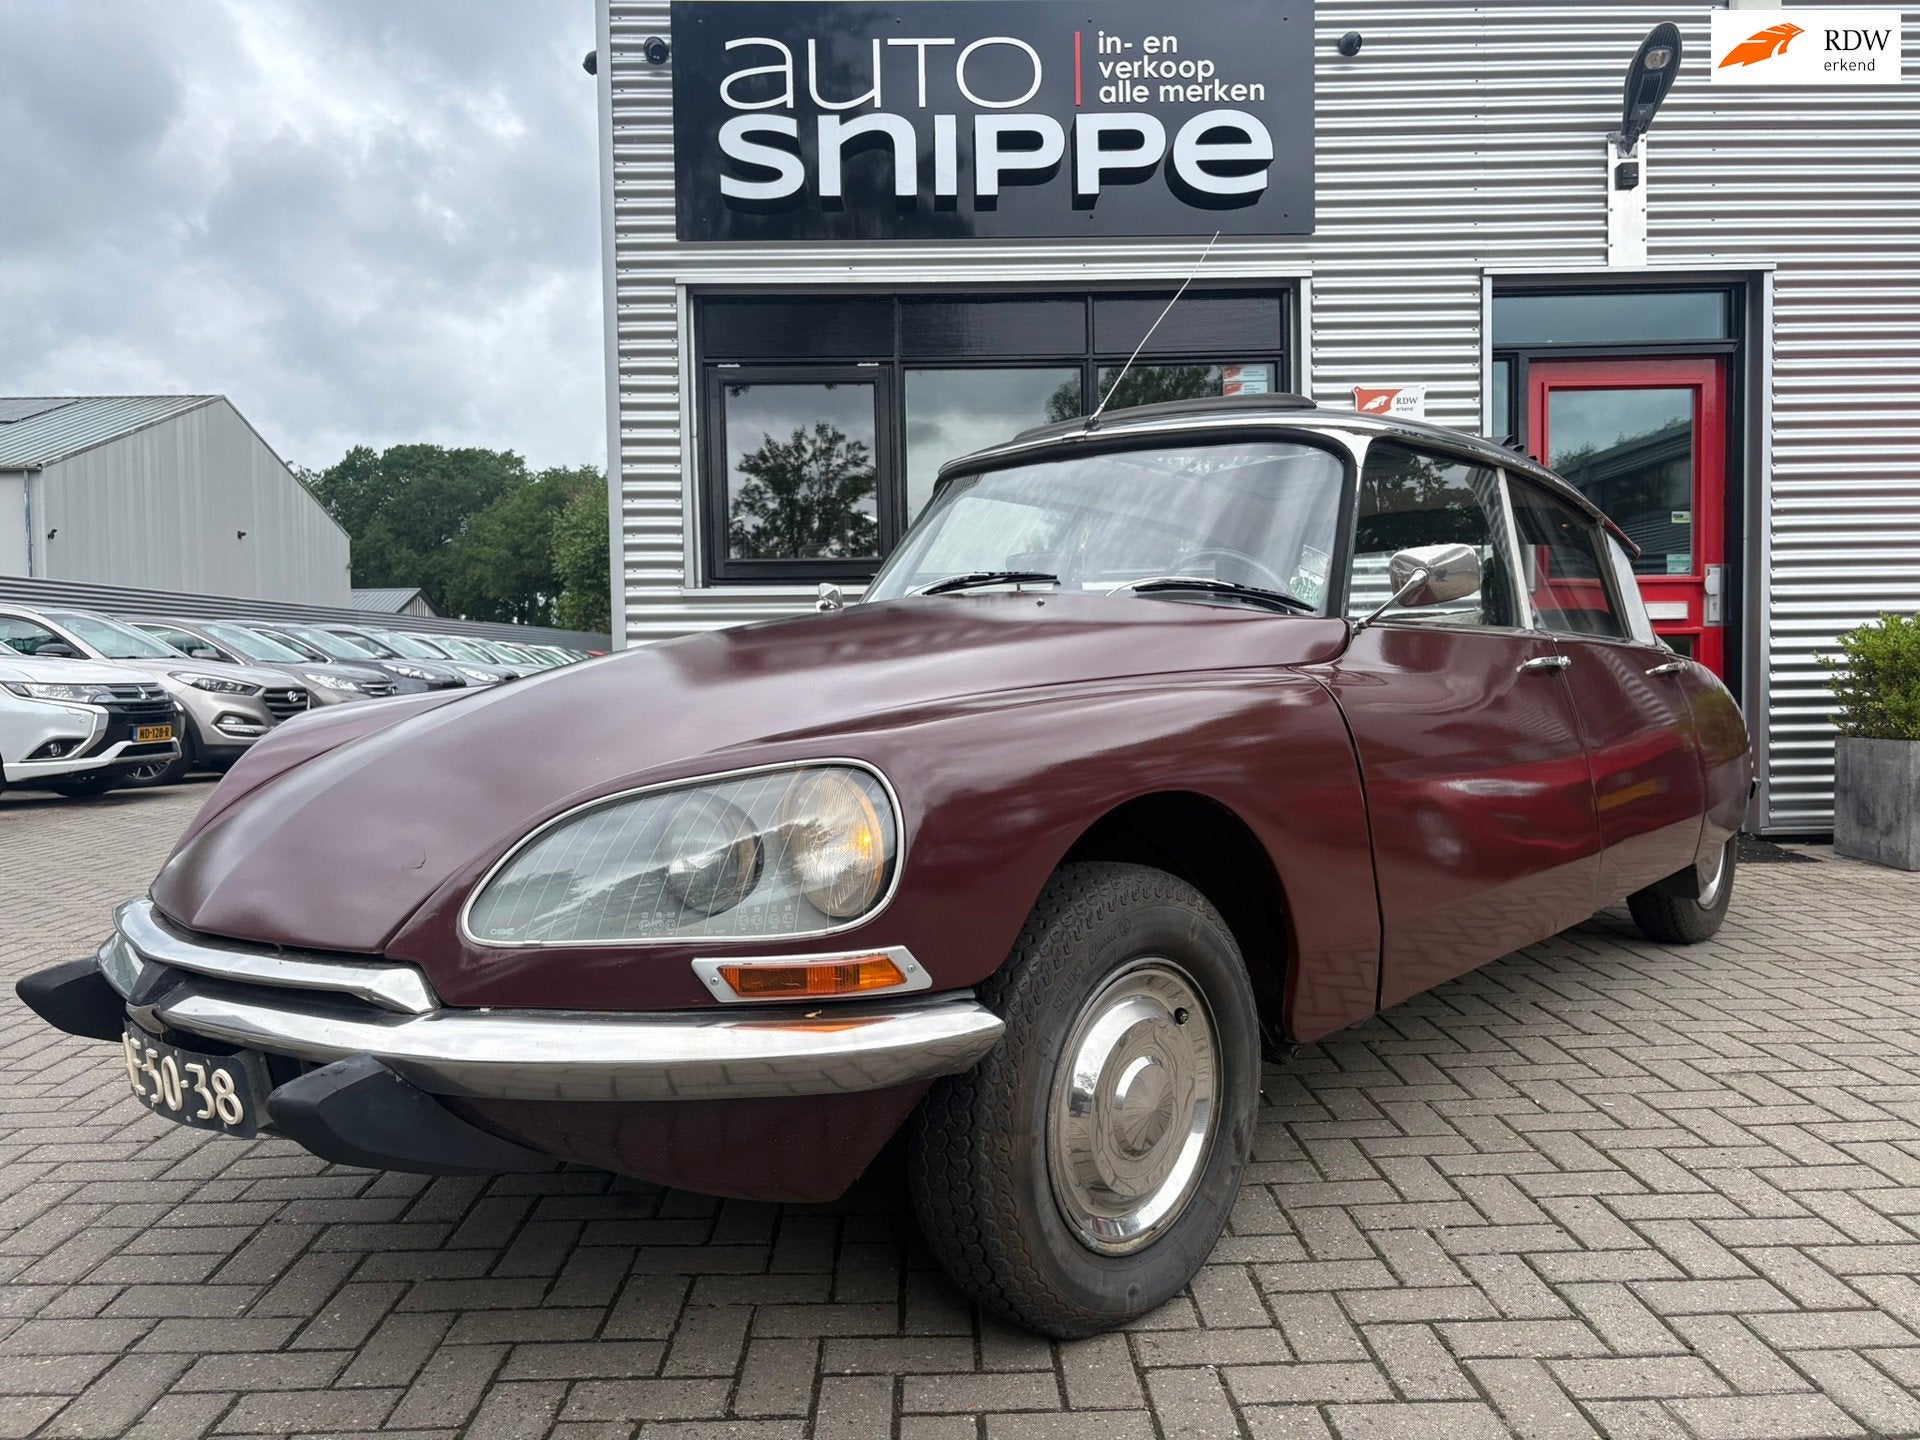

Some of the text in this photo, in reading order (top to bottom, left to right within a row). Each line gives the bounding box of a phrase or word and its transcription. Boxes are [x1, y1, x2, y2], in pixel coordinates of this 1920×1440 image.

[1098, 30, 1178, 54] in- en
[1098, 55, 1215, 82] verkoop
[1099, 78, 1266, 103] alle merken
[1396, 397, 1418, 405] RDW
[140, 726, 170, 740] ND-128-R
